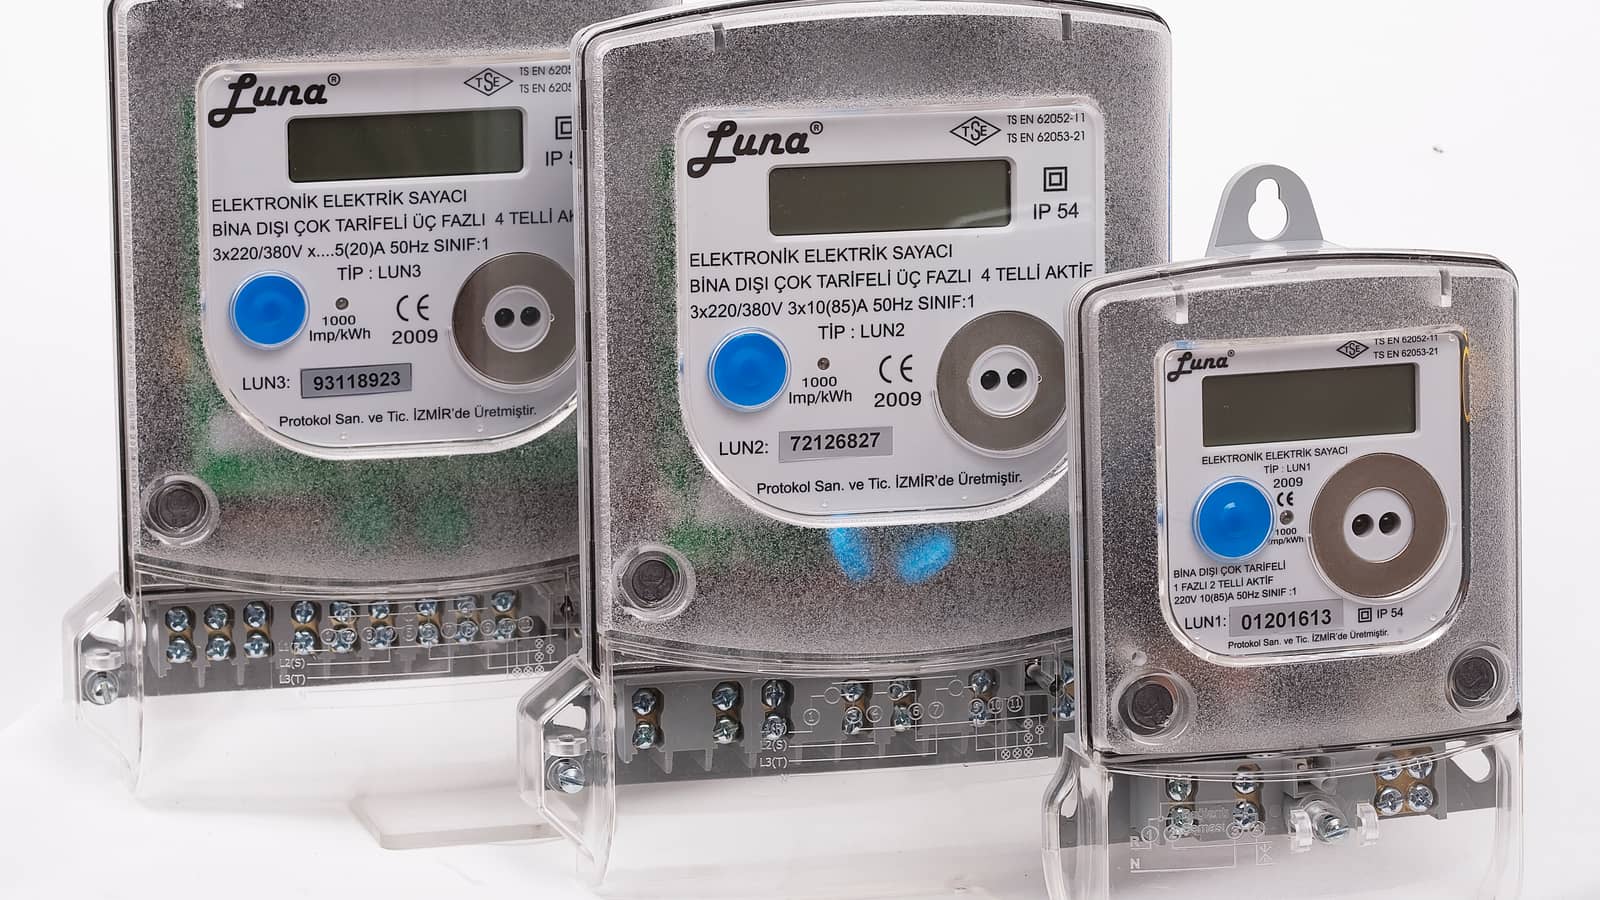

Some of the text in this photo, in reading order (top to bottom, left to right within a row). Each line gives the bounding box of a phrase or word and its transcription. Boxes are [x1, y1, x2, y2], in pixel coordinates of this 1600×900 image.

[520, 67, 529, 76] TS
[532, 66, 545, 76] EN
[520, 84, 529, 93] TS
[532, 84, 545, 93] EN
[1007, 113, 1084, 125] TS EN 62052-11
[1007, 131, 1084, 143] TS EN 62053-21
[546, 151, 563, 166] IP
[212, 190, 466, 212] ELEKTRONİK ELEKTRİK SAYACI
[1034, 202, 1079, 219] IP 54
[213, 221, 251, 237] BİNA
[257, 221, 288, 237] DIŞI
[294, 219, 330, 237] ÇOK
[335, 214, 407, 232] TARİFELİ
[413, 213, 436, 231] ÜÇ
[442, 213, 485, 227] FAZLI
[495, 212, 504, 225] 4
[509, 208, 552, 224] TELLİ
[213, 245, 302, 261] 3x220/380V
[391, 240, 429, 254] 50Hz
[434, 237, 487, 252] SINIF:1
[690, 244, 952, 267] ELEKTRONİK ELEKTRİK SAYACI
[337, 265, 363, 280] TİP
[379, 264, 421, 279] LUN3
[691, 262, 1093, 294] BİNA DIŞI ÇOK TARİFELİ ÜÇ FAZLI 4 TELLİ AKTİF
[396, 294, 430, 322] CE
[691, 295, 973, 319] 3x220/380V 3x10(85)A 50Hz SINIF:1
[322, 315, 356, 326] 1000
[310, 328, 370, 343] Imp/kWh
[392, 329, 438, 344] 2009
[818, 323, 845, 340] TİP
[861, 323, 904, 338] LUN2
[1402, 335, 1437, 343] 62052-11
[1373, 348, 1437, 359] TS EN 62053-21
[878, 354, 913, 384] CE
[243, 371, 400, 393] LUN3: 93118923
[802, 376, 837, 387] 1000
[789, 390, 852, 406] Imp/kWh
[874, 392, 921, 407] 2009
[280, 414, 330, 426] Protokol
[336, 414, 363, 424] San.
[368, 414, 383, 423] ve
[387, 411, 408, 422] Tic.
[475, 404, 536, 418] Üretmiştir.
[720, 432, 880, 455] LUN2: 72126827
[1202, 446, 1347, 464] ELEKTRONİK ELEKTRİK SAYACI
[1264, 464, 1279, 474] TİP
[1287, 463, 1310, 472] LUN1
[757, 481, 810, 494] Protokol
[815, 480, 844, 492] San.
[849, 481, 864, 490] ve
[868, 478, 890, 489] Tic.
[959, 472, 1022, 486] Üretmiştir.
[1274, 477, 1303, 488] 2009
[1277, 491, 1293, 507] CE
[1174, 560, 1285, 578] BİNA DIŞI ÇOK TARİFELİ
[1182, 582, 1207, 591] FAZLI
[1210, 581, 1215, 589] 2
[1218, 577, 1243, 588] TELLİ
[1246, 575, 1273, 586] AKTİF
[1175, 595, 1197, 605] 220V
[1200, 592, 1234, 603] 10(85)A
[1237, 591, 1259, 600] 50Hz
[1262, 588, 1286, 598] SINIF
[1185, 609, 1331, 630] LUN1: 01201613
[1377, 608, 1403, 618] IP 54
[1228, 640, 1261, 648] Protokol
[280, 658, 305, 669] L2(S)
[280, 674, 306, 685] L3(T)
[760, 757, 788, 768] L3(T)
[1130, 835, 1140, 847] R
[1130, 858, 1140, 869] N
